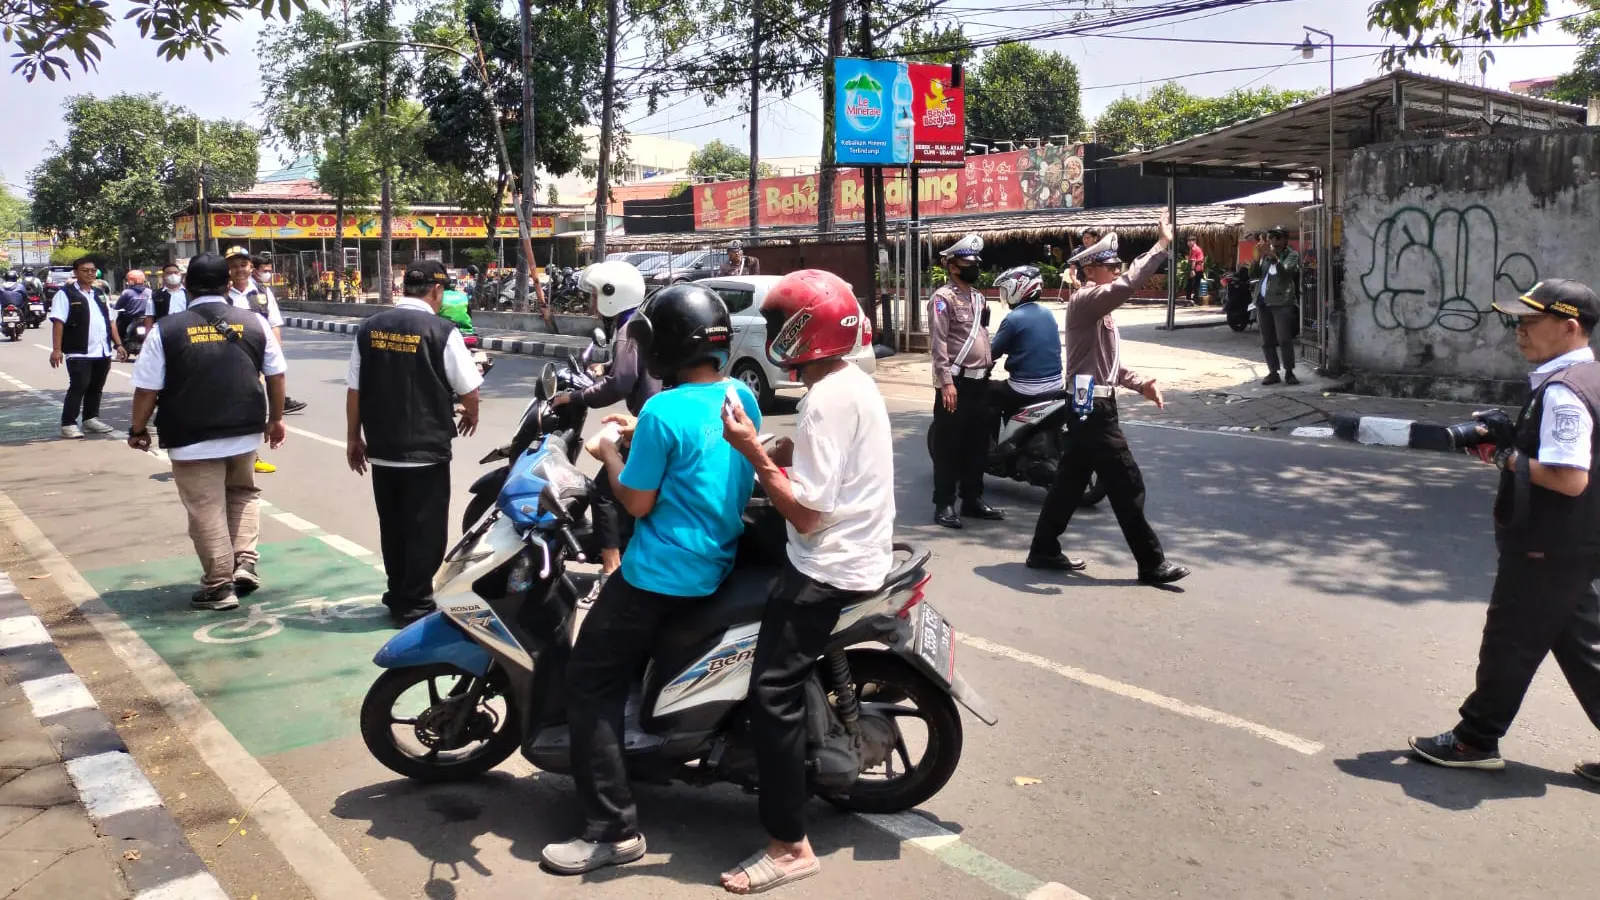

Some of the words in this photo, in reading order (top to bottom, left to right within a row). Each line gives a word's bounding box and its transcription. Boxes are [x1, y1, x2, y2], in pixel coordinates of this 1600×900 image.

[858, 95, 869, 106] Le
[846, 105, 882, 116] Minerale
[927, 108, 951, 118] Bebek
[766, 183, 819, 216] Bebe
[841, 167, 959, 210] Bodjang
[214, 214, 357, 227] SEAFOOD
[435, 216, 484, 228] IKAN
[843, 316, 858, 326] JP
[704, 326, 728, 334] HONDA
[450, 604, 481, 613] HONDA
